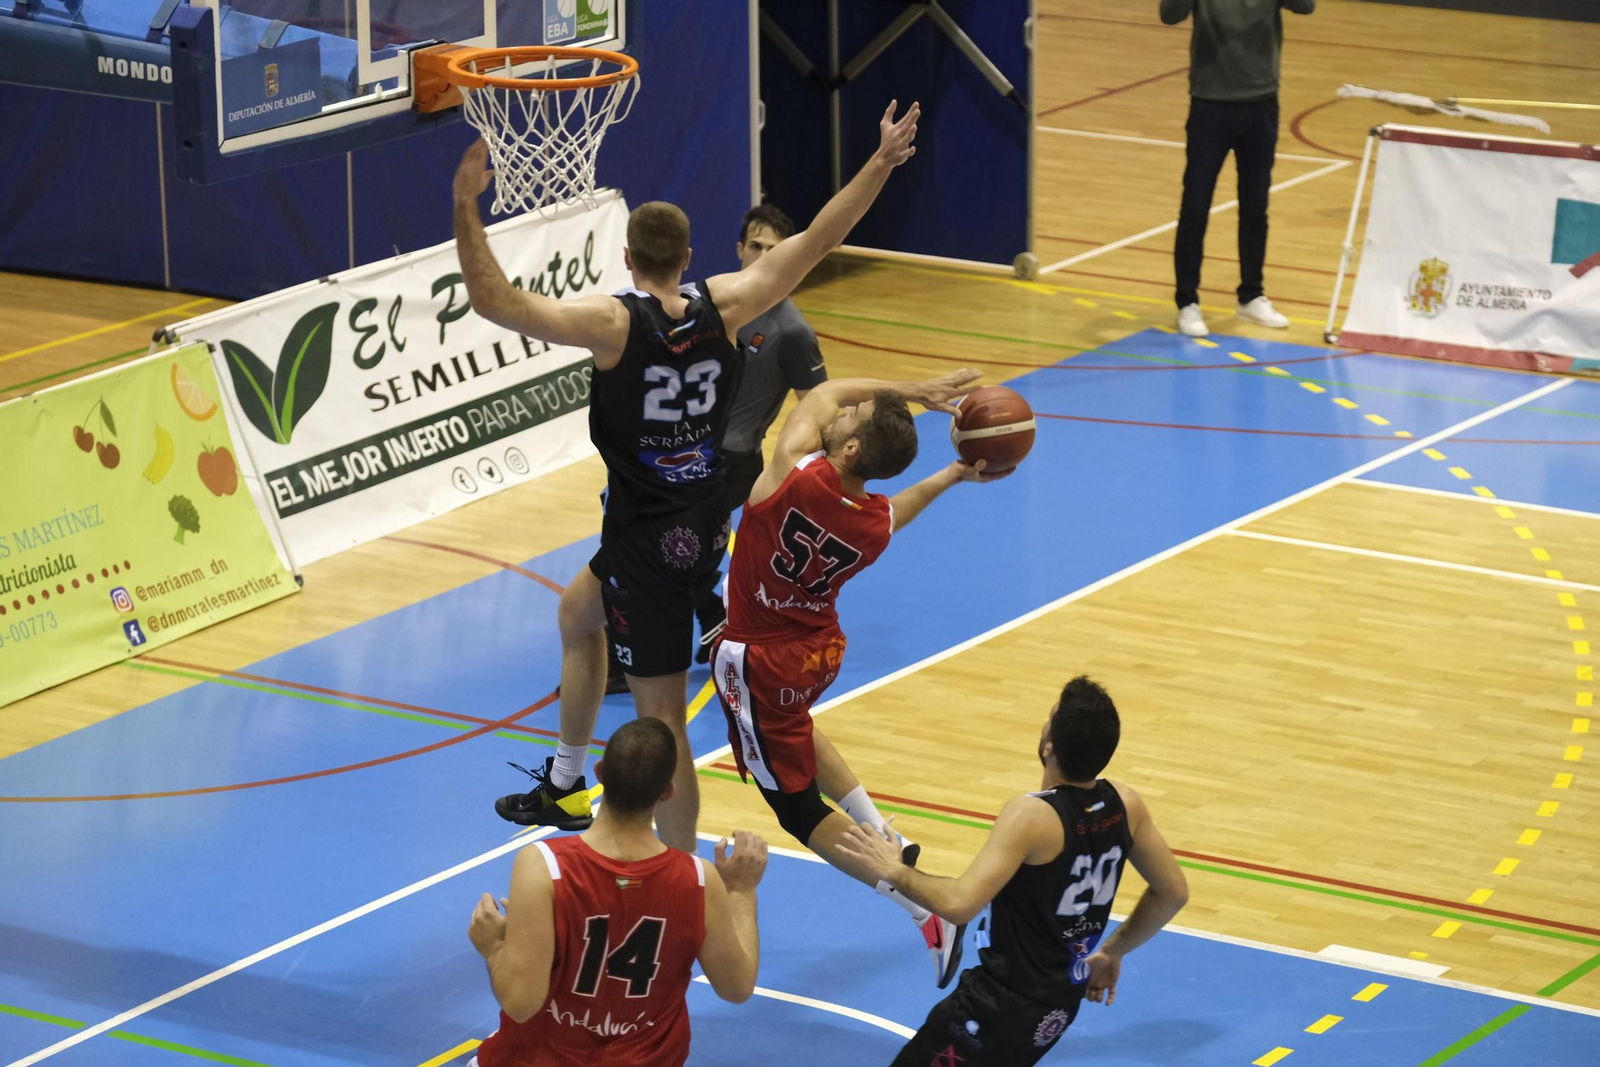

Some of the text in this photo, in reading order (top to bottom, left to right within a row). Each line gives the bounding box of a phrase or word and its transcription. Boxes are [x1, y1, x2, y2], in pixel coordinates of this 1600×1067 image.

[547, 22, 568, 38] EBA
[97, 55, 173, 84] MONDO
[228, 89, 316, 122] DIPUTACIÓN DE ALMERÍA
[348, 230, 603, 370] El Pntel
[1456, 294, 1473, 307] DE
[1460, 283, 1552, 300] AYUNTAMIENTO
[642, 358, 722, 422] 23
[639, 423, 711, 449] SERRADA
[674, 421, 691, 435] LA
[270, 476, 305, 509] EL
[299, 445, 387, 498] MEJOR
[383, 418, 470, 468] INJERTO
[466, 394, 533, 438] PARA
[12, 503, 105, 553] MARTÍNEZ
[770, 506, 862, 597] 57
[135, 558, 229, 602] @mariamm_dn
[147, 572, 282, 633] @dnmoralesmartinez
[615, 643, 633, 666] 23
[1056, 845, 1122, 916] 20
[571, 914, 667, 998] 14
